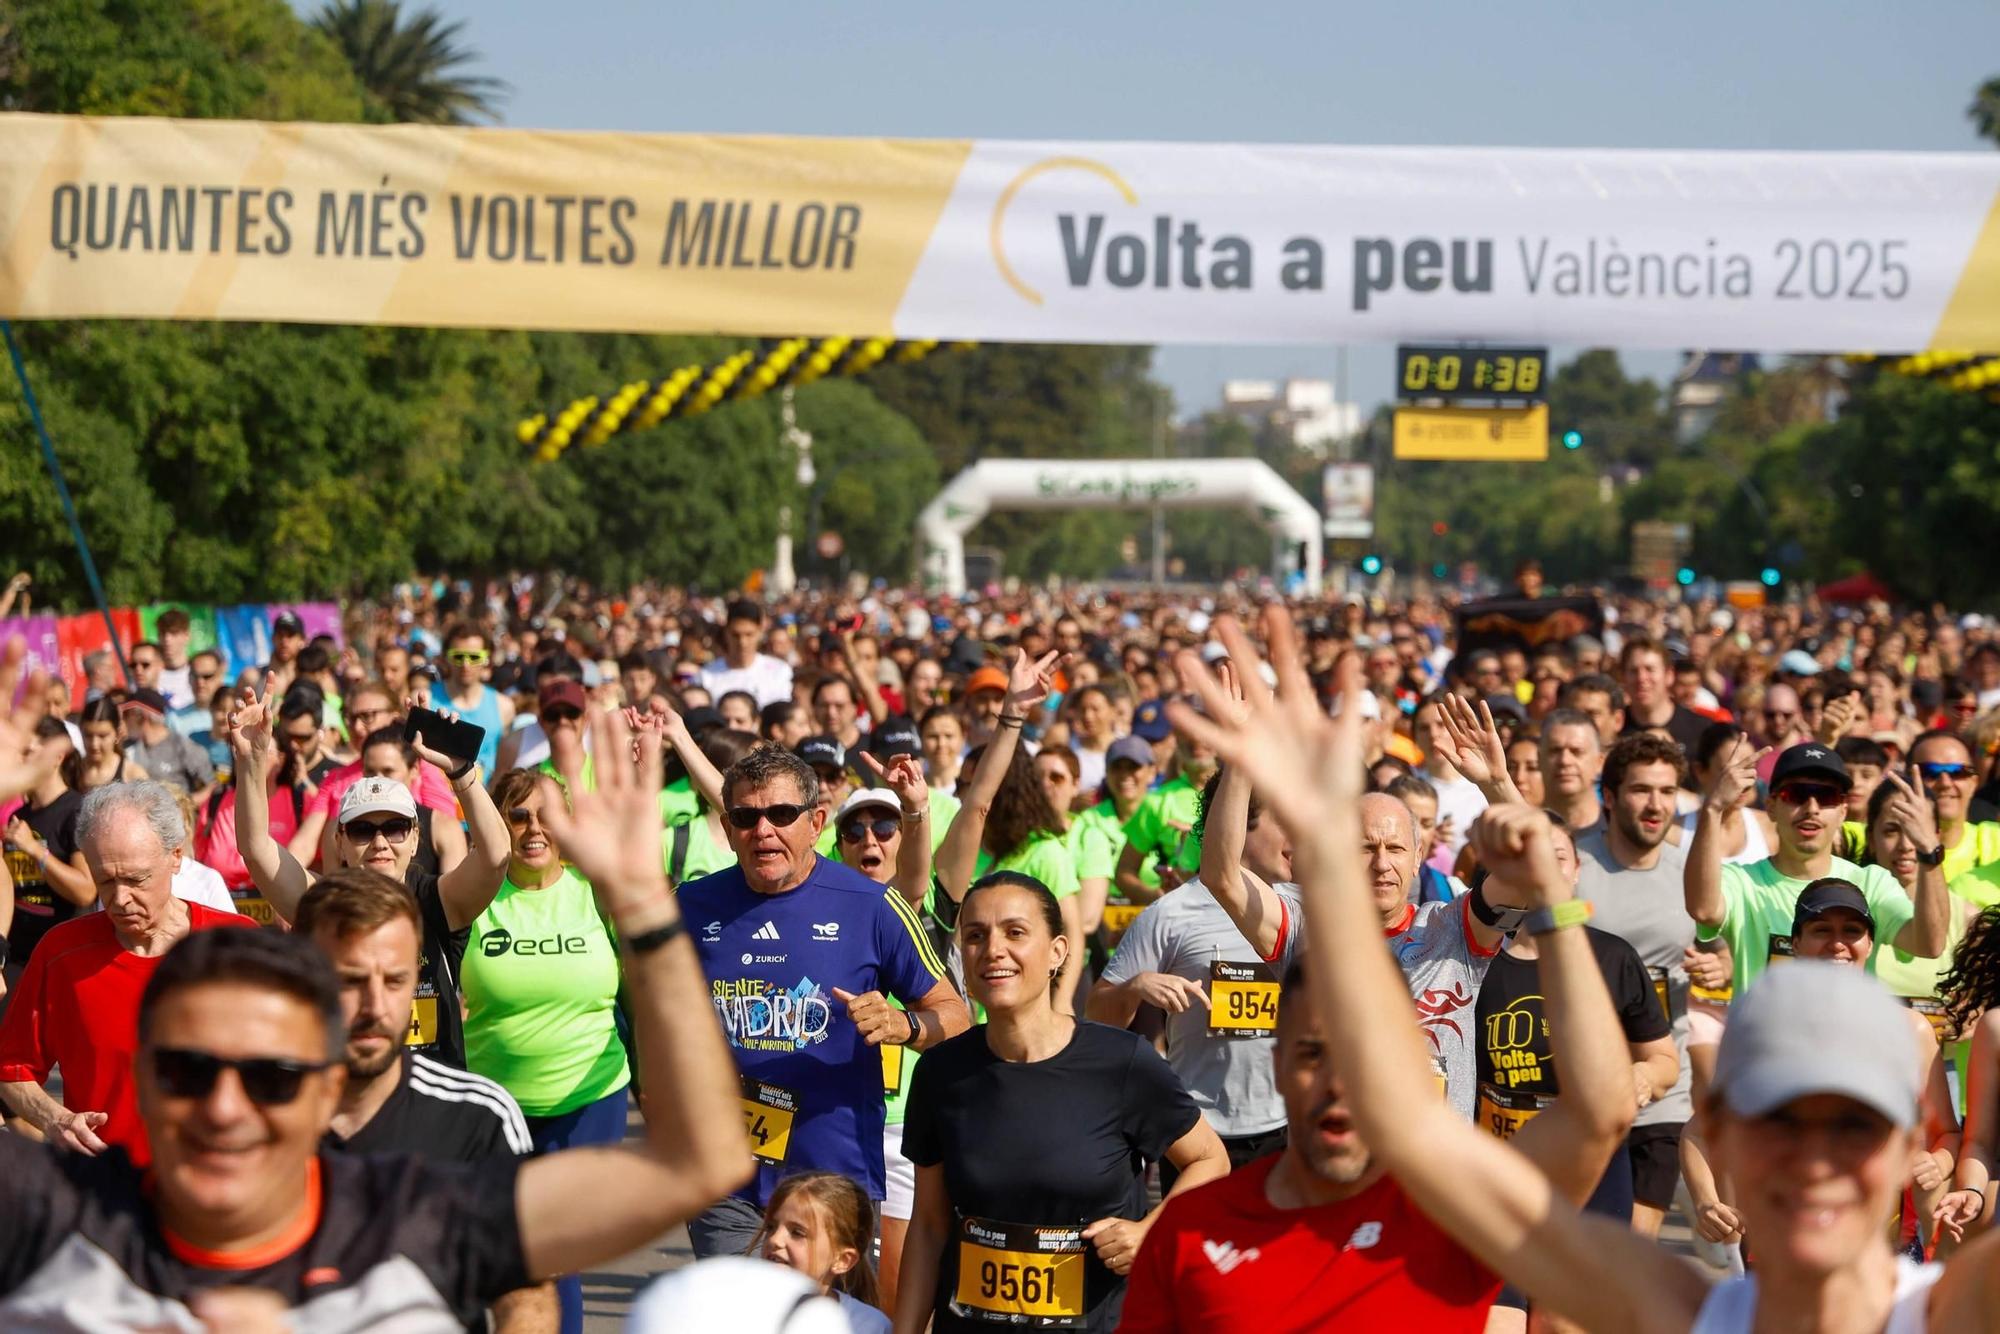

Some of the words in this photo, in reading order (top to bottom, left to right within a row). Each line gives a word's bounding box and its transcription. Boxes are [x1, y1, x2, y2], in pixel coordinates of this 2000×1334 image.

[51, 183, 294, 261] QUANTES
[315, 174, 425, 257] MÉS
[450, 194, 638, 266] VOLTES
[660, 200, 861, 270] MILLOR
[1058, 214, 1253, 290] Volta
[1280, 235, 1323, 290] a
[1353, 238, 1493, 311] peu
[1517, 237, 1752, 298] València
[1774, 238, 1911, 300] 2025
[755, 954, 786, 963] ZURICH
[1221, 967, 1237, 975] Volta
[713, 978, 764, 1000] SIENTE
[1486, 1010, 1533, 1050] 100
[1490, 1050, 1537, 1069] Volta
[1494, 1071, 1505, 1084] a
[1508, 1066, 1542, 1088] peu
[970, 1225, 985, 1237] Volta
[992, 1232, 1006, 1241] peu
[981, 1260, 1055, 1304] 9561
